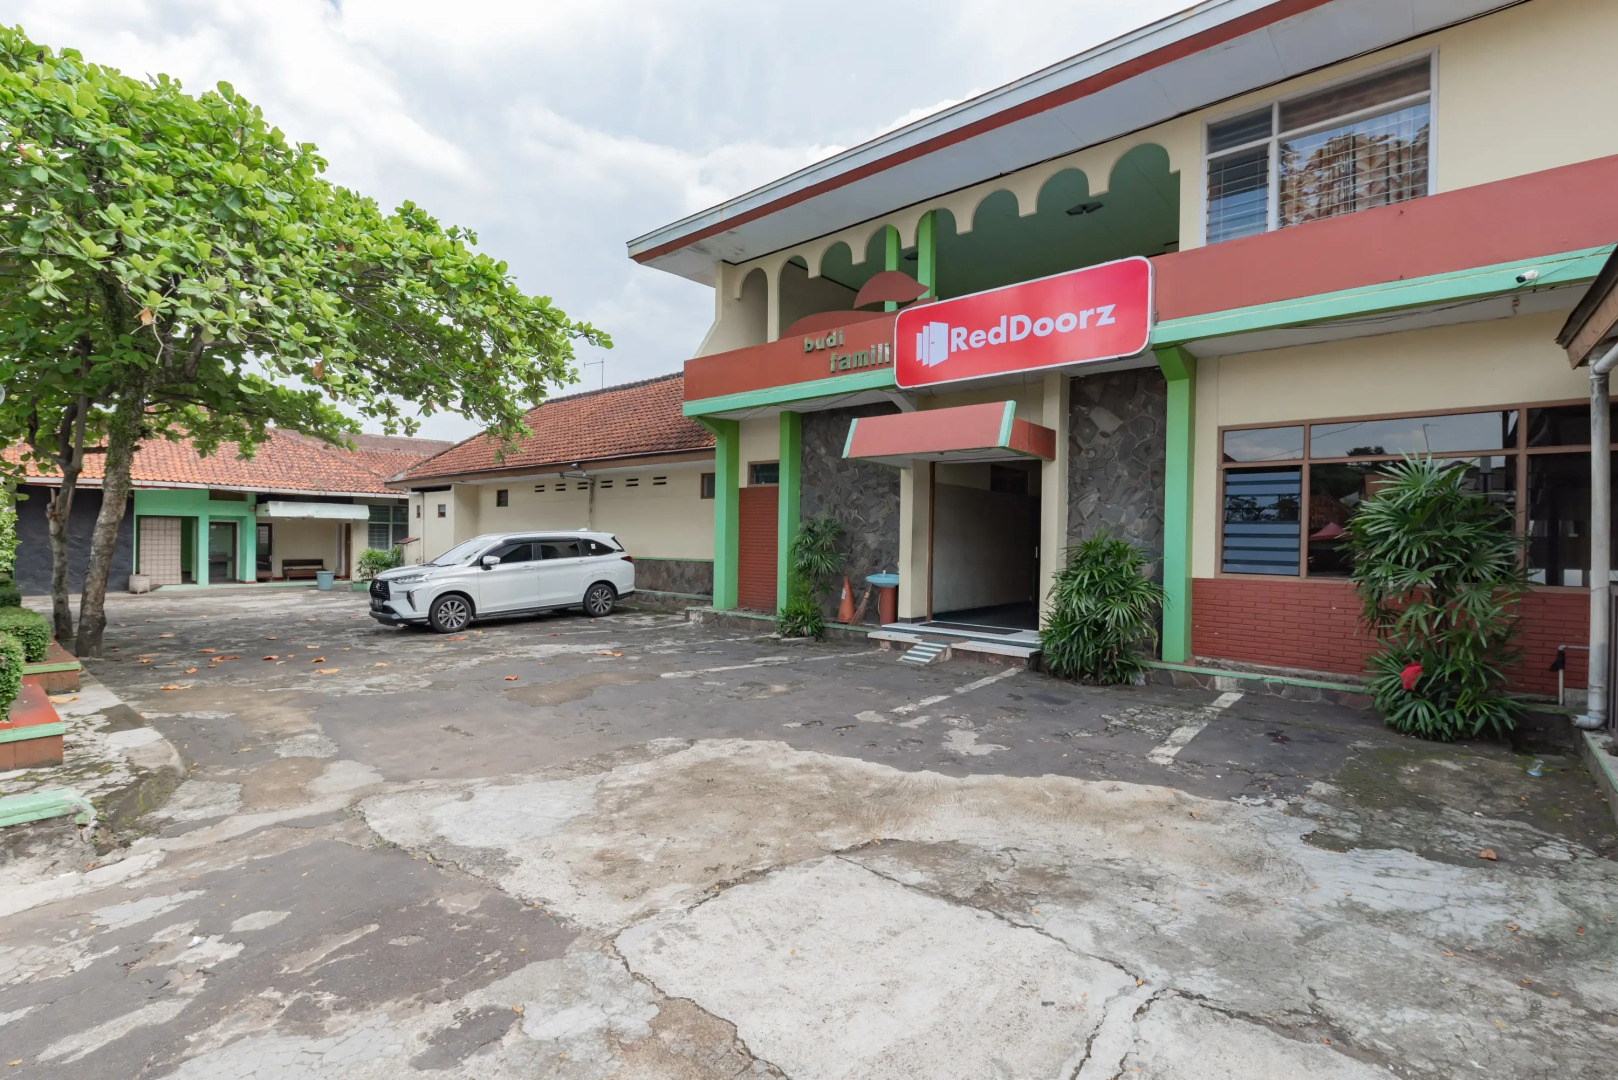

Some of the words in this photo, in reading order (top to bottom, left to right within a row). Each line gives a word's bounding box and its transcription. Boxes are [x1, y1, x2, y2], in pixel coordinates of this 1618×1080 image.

[804, 330, 844, 353] budi
[951, 304, 1116, 352] RedDoorz
[830, 342, 890, 372] famili
